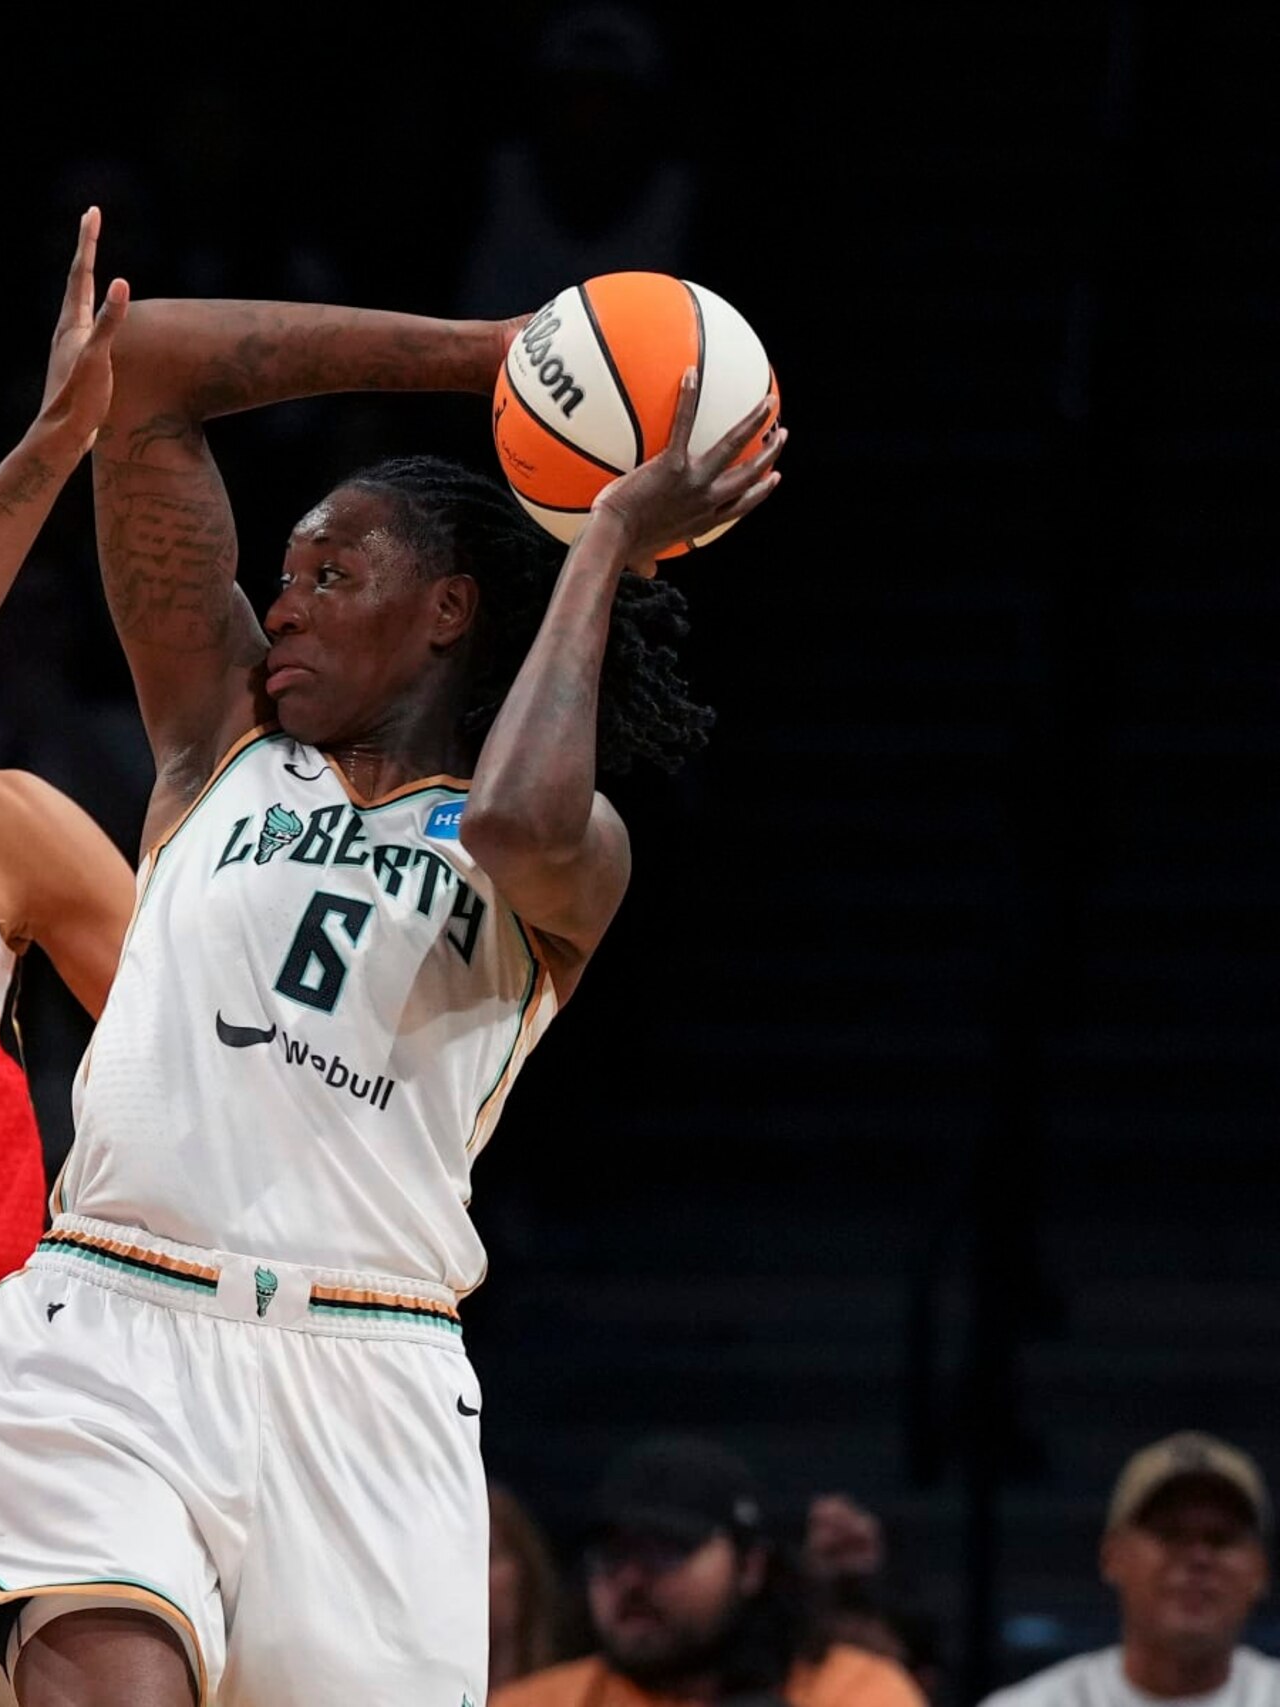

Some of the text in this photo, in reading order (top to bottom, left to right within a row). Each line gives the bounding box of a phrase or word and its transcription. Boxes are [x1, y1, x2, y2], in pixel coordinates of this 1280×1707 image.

[522, 301, 584, 418] ilson
[434, 813, 462, 826] HS
[273, 889, 375, 1015] 6
[282, 1030, 396, 1111] Webull
